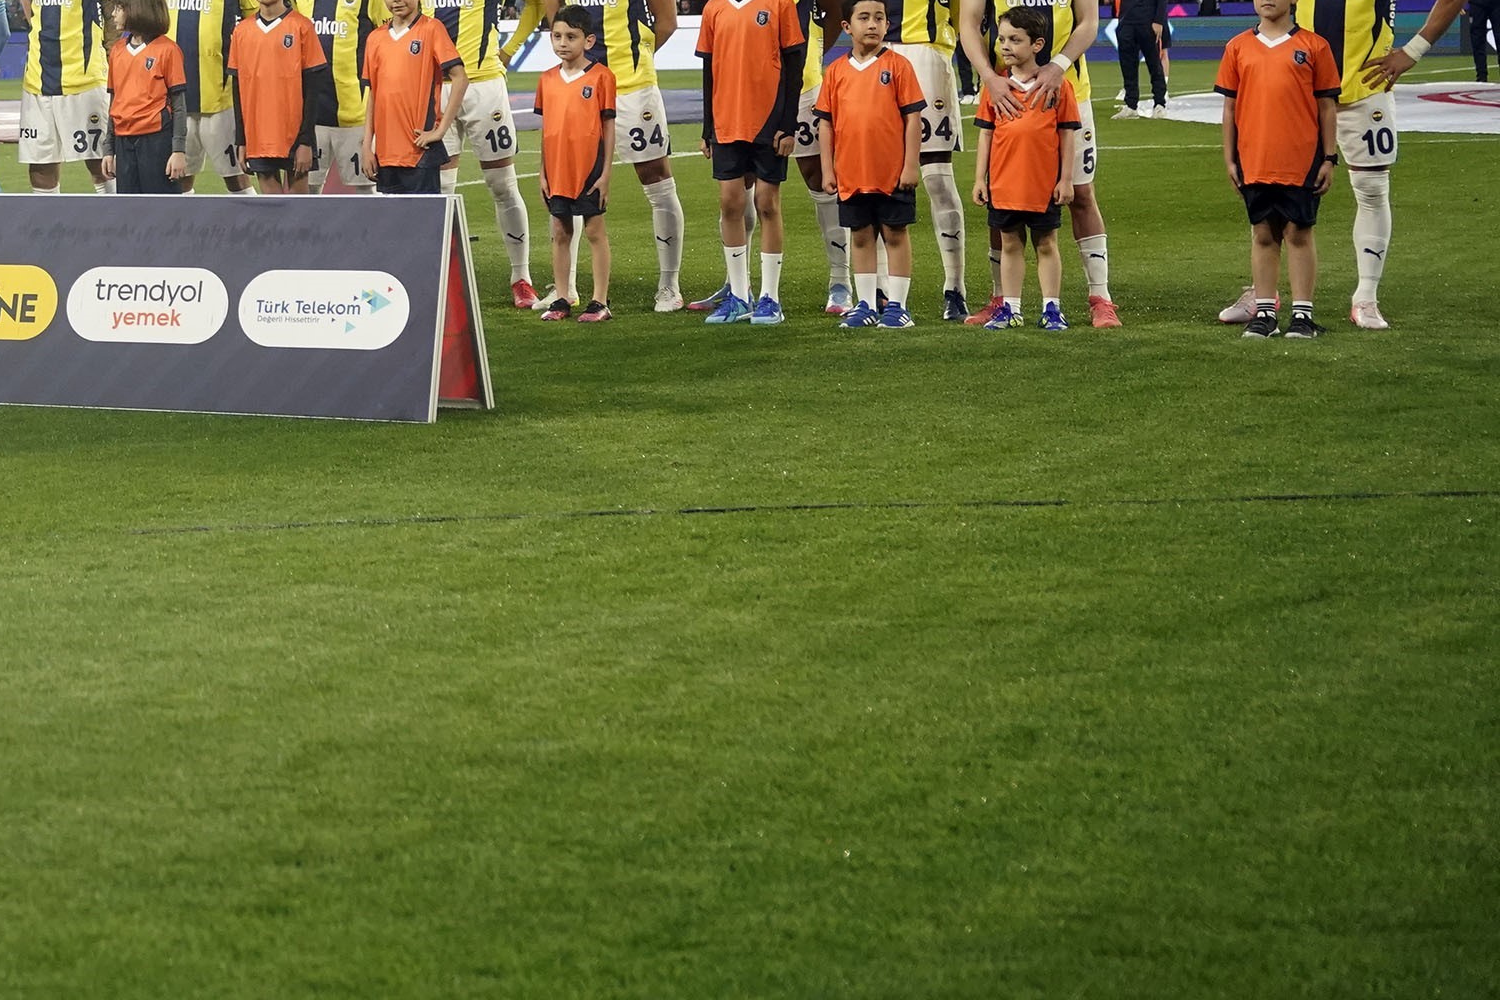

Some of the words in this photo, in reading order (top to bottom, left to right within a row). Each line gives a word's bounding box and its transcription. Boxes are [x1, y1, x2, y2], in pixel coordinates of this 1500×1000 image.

[73, 129, 102, 153] 37
[485, 125, 513, 153] 18
[629, 123, 664, 151] 34
[1361, 127, 1394, 157] 10
[96, 278, 203, 308] trendyol
[111, 307, 182, 330] yemek
[256, 299, 290, 314] Türk
[296, 299, 362, 316] Telekom
[257, 314, 283, 323] Değerli
